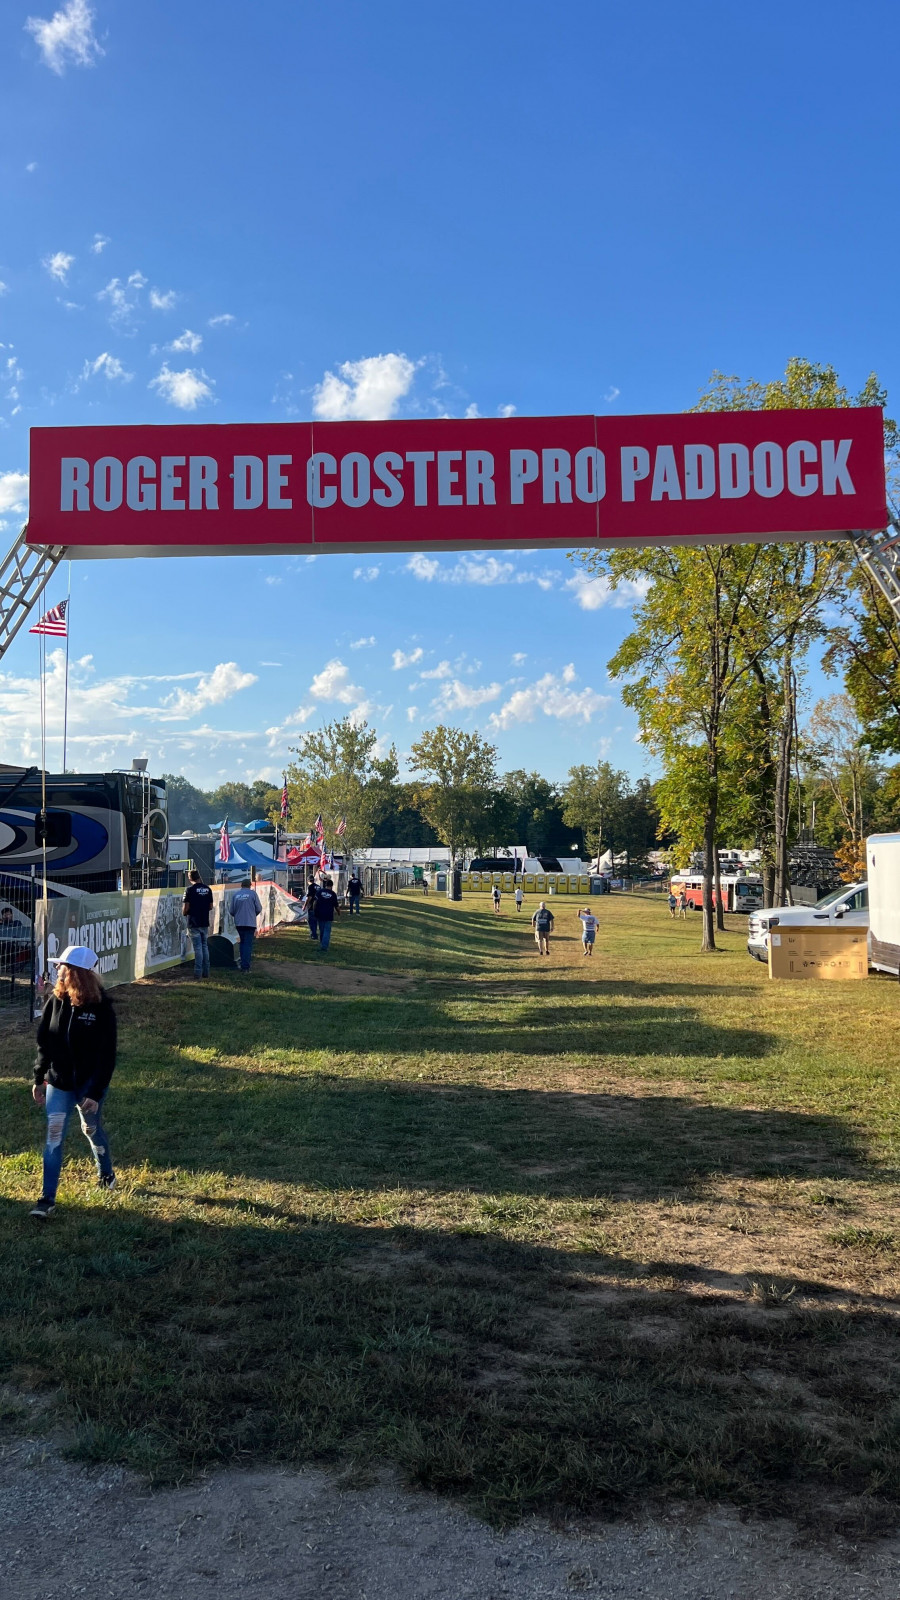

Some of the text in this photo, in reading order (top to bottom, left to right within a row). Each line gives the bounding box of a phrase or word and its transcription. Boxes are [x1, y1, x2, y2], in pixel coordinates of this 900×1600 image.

[61, 439, 857, 511] ROGER DE COSTER PRO PADDOCK
[96, 922, 105, 953] DE
